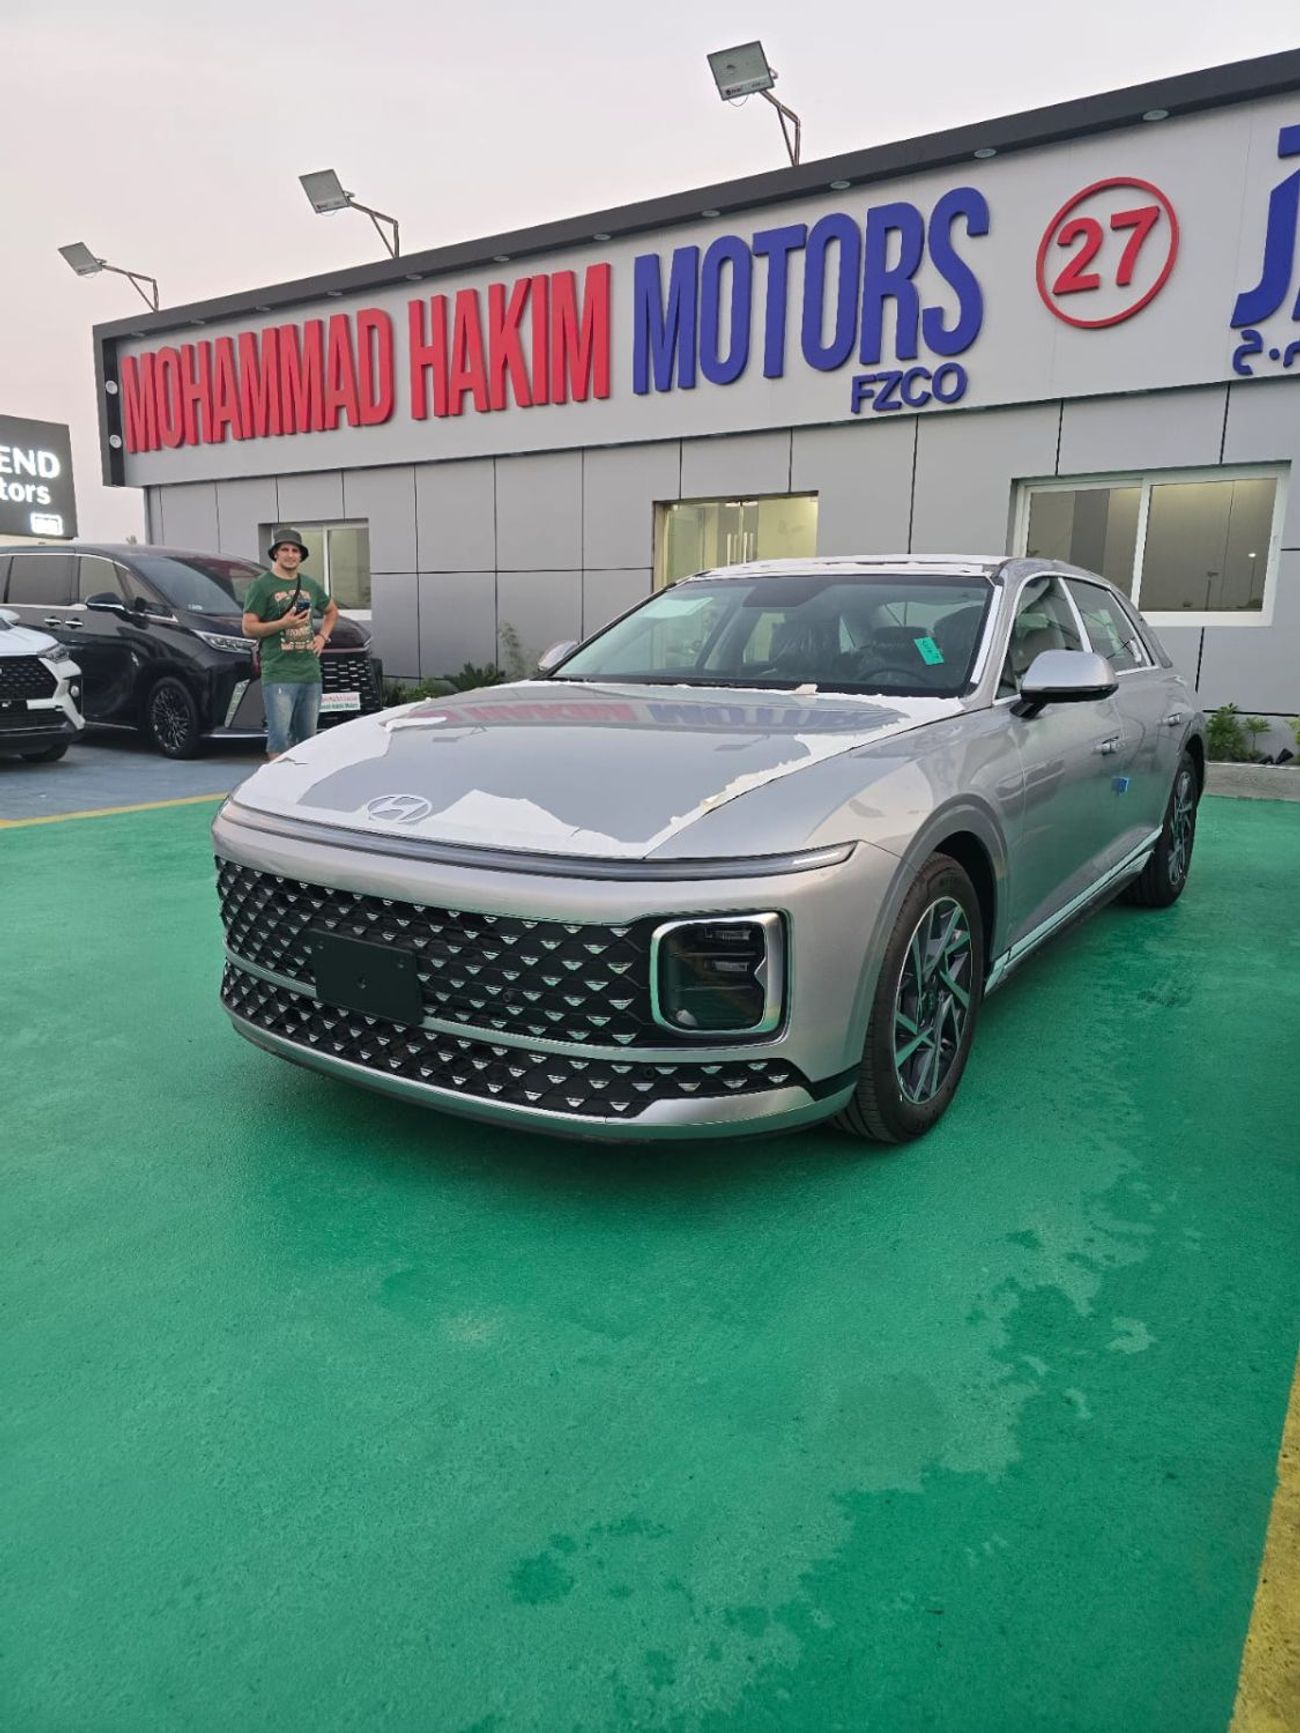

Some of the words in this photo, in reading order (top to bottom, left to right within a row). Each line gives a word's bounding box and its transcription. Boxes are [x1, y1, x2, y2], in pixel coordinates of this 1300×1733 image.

[1052, 206, 1160, 295] 27
[121, 308, 396, 454] MOHAMMAD
[408, 262, 612, 421] HAKIM
[632, 186, 990, 396] MOTORS
[851, 362, 968, 413] FZCO
[0, 445, 61, 479] END
